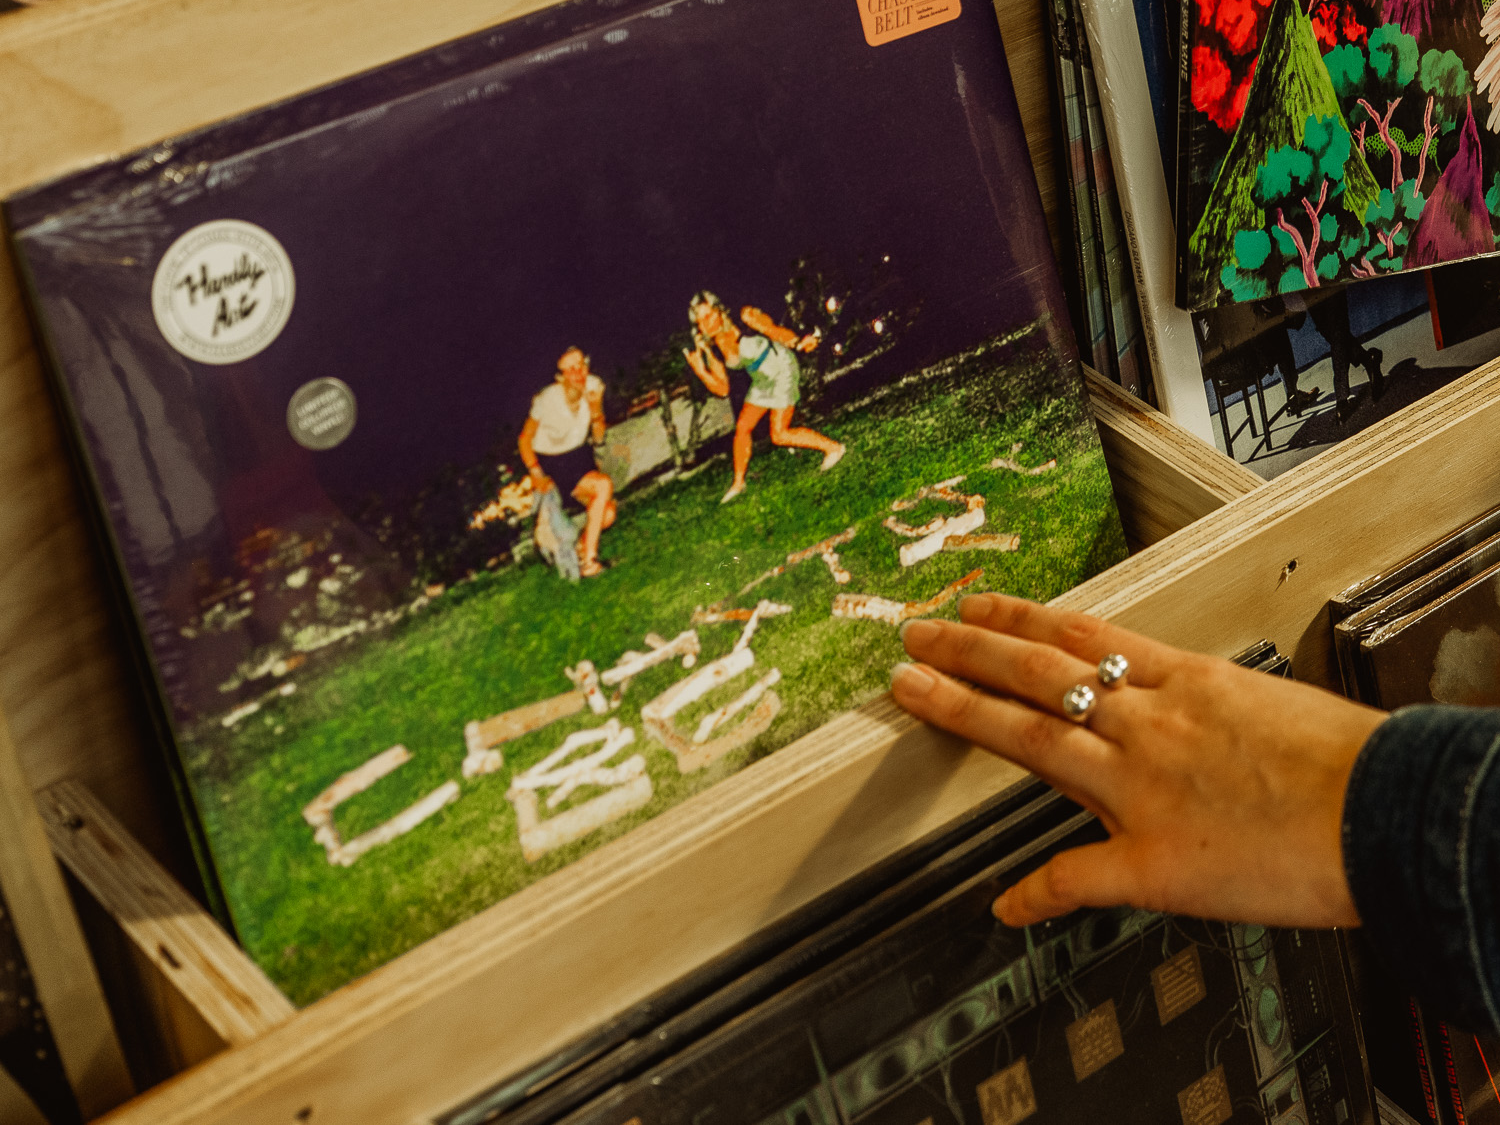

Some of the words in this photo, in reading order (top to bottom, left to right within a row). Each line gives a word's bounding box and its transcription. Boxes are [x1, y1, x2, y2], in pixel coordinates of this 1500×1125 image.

[875, 5, 913, 35] BELT
[1125, 211, 1137, 251] CHICANO
[1450, 1086, 1466, 1125] WIZAR
